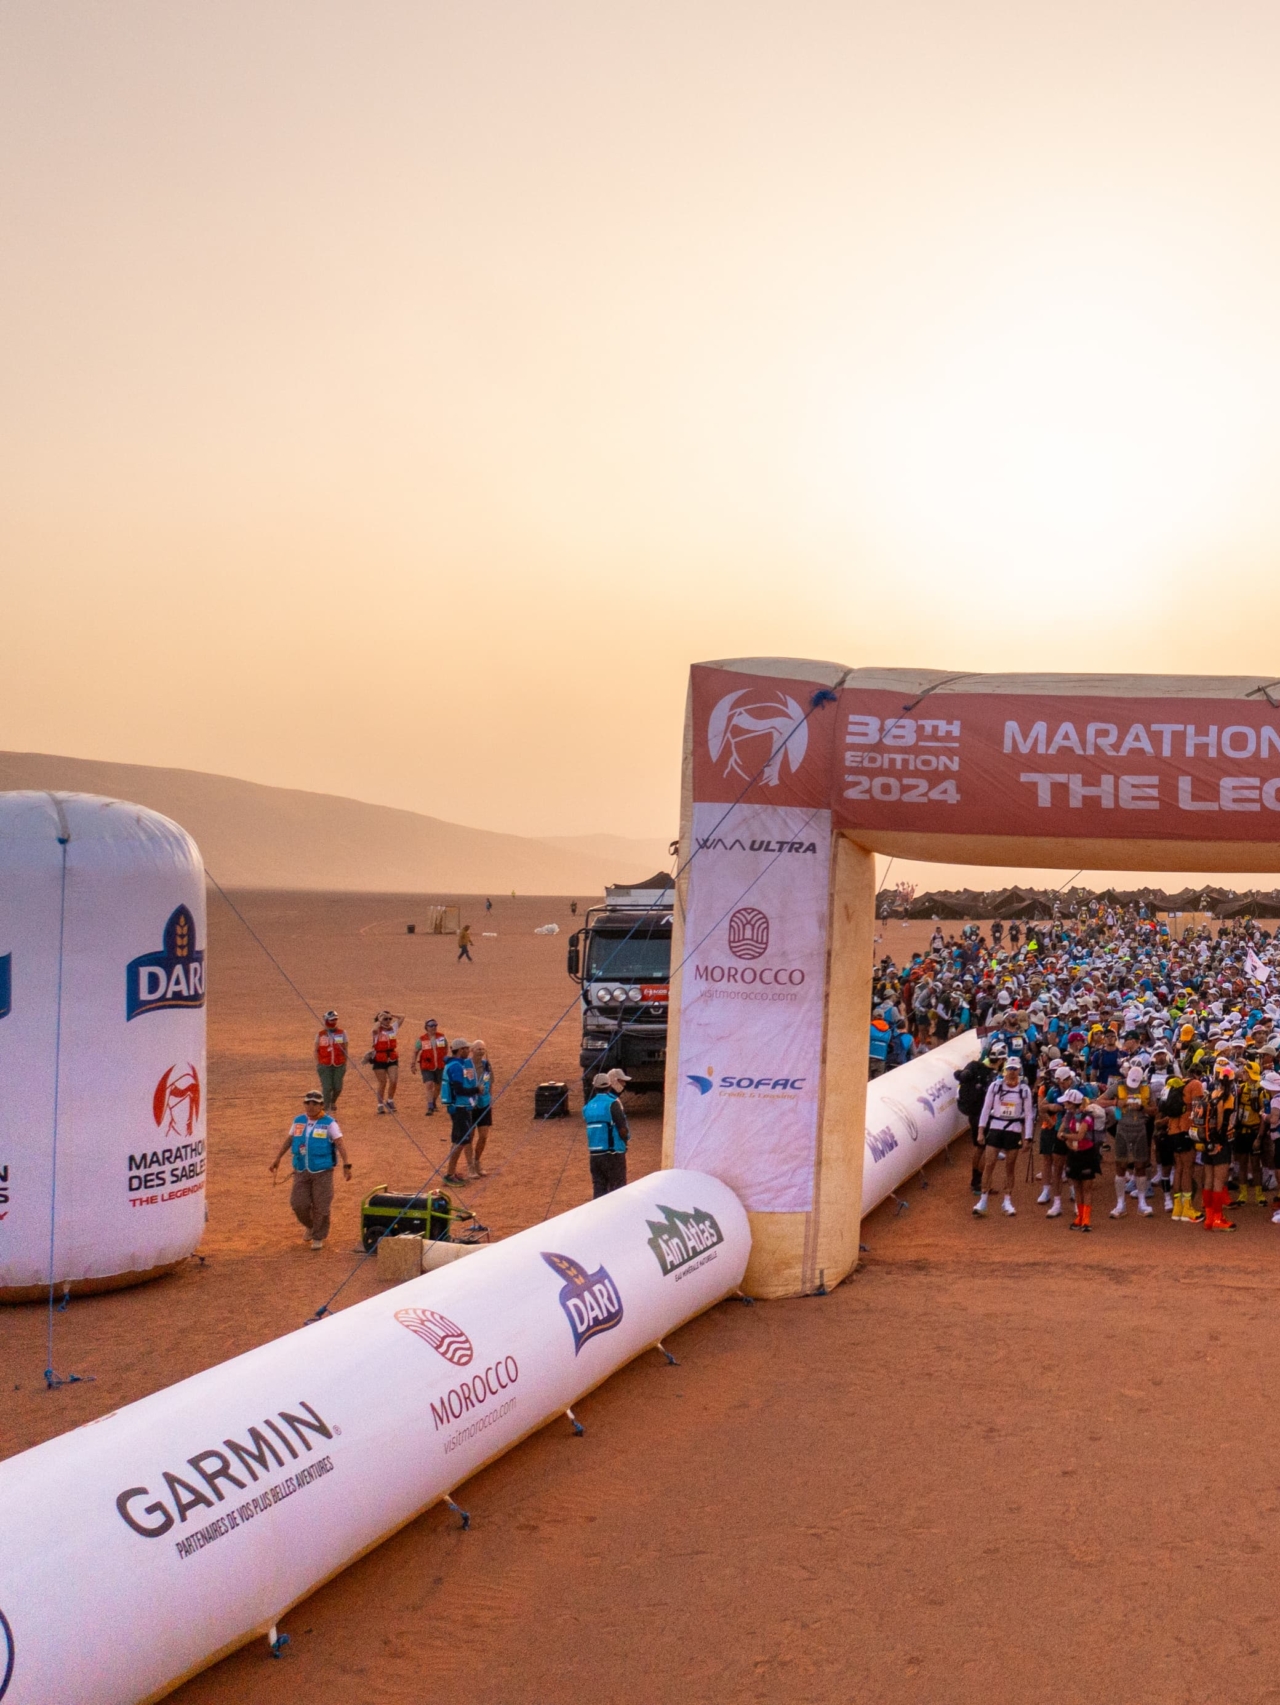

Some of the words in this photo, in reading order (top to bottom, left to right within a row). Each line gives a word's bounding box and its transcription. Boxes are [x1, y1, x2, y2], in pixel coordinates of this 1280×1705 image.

[845, 714, 961, 747] 38TH
[844, 751, 959, 771] EDITION
[843, 775, 961, 804] 2024
[1020, 773, 1160, 810] THE
[749, 840, 817, 854] ULTRA
[694, 964, 805, 986] MOROCCO
[719, 1076, 806, 1090] SOFAC
[128, 1139, 205, 1171] MARATHO
[128, 1171, 166, 1192] DES
[170, 1158, 205, 1184] SABLE
[129, 1195, 158, 1207] THE
[673, 1218, 717, 1256] Atlas
[566, 1279, 618, 1333] DARI
[430, 1355, 518, 1431] MOROCCO
[443, 1396, 517, 1454] visitmorocco.com
[116, 1401, 333, 1538] GARMIN
[175, 1517, 229, 1559] PARTENAIRES
[226, 1511, 240, 1530] DE
[236, 1502, 254, 1524] VOS
[251, 1491, 272, 1515] PLUS
[270, 1477, 296, 1504] BELLES
[295, 1455, 334, 1489] AVENTURES
